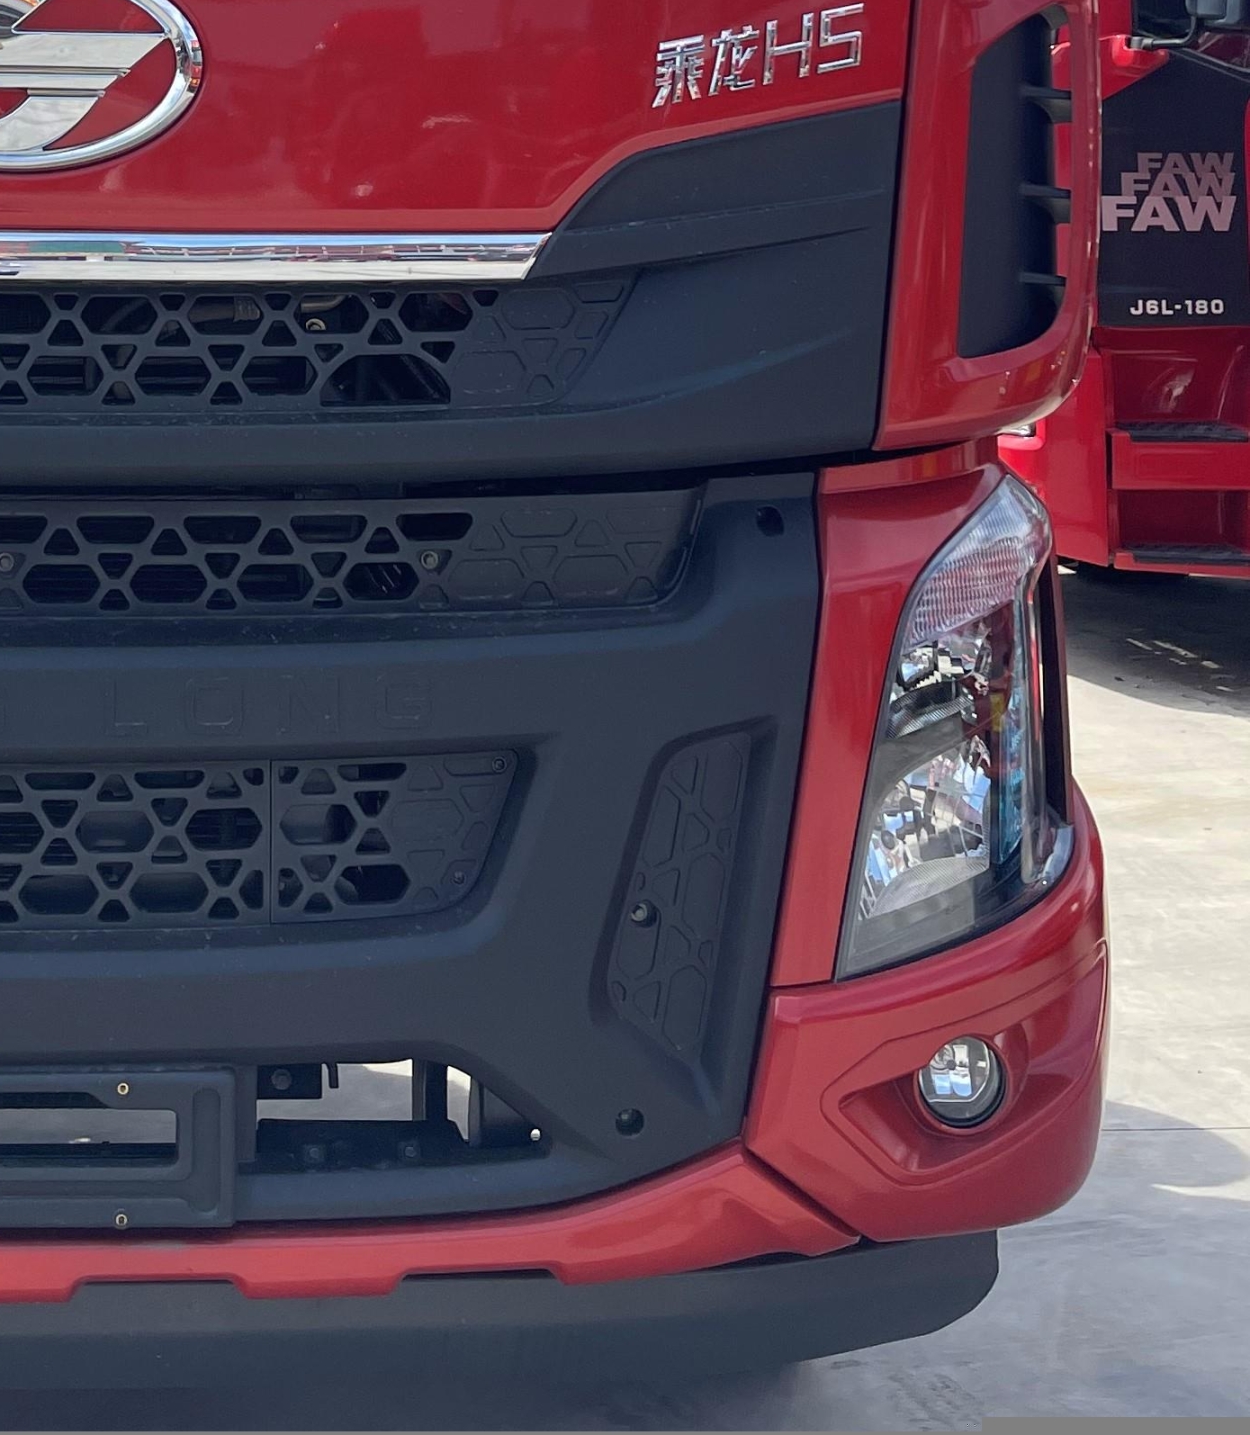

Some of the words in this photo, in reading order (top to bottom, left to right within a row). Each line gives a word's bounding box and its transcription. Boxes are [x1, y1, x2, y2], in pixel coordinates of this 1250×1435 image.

[652, 3, 864, 108] 乘龙H5
[1137, 152, 1235, 177] FAW
[1121, 172, 1235, 202] FAW
[1102, 195, 1237, 232] FAW
[1130, 299, 1225, 316] J6L-180
[103, 674, 435, 738] LONG
